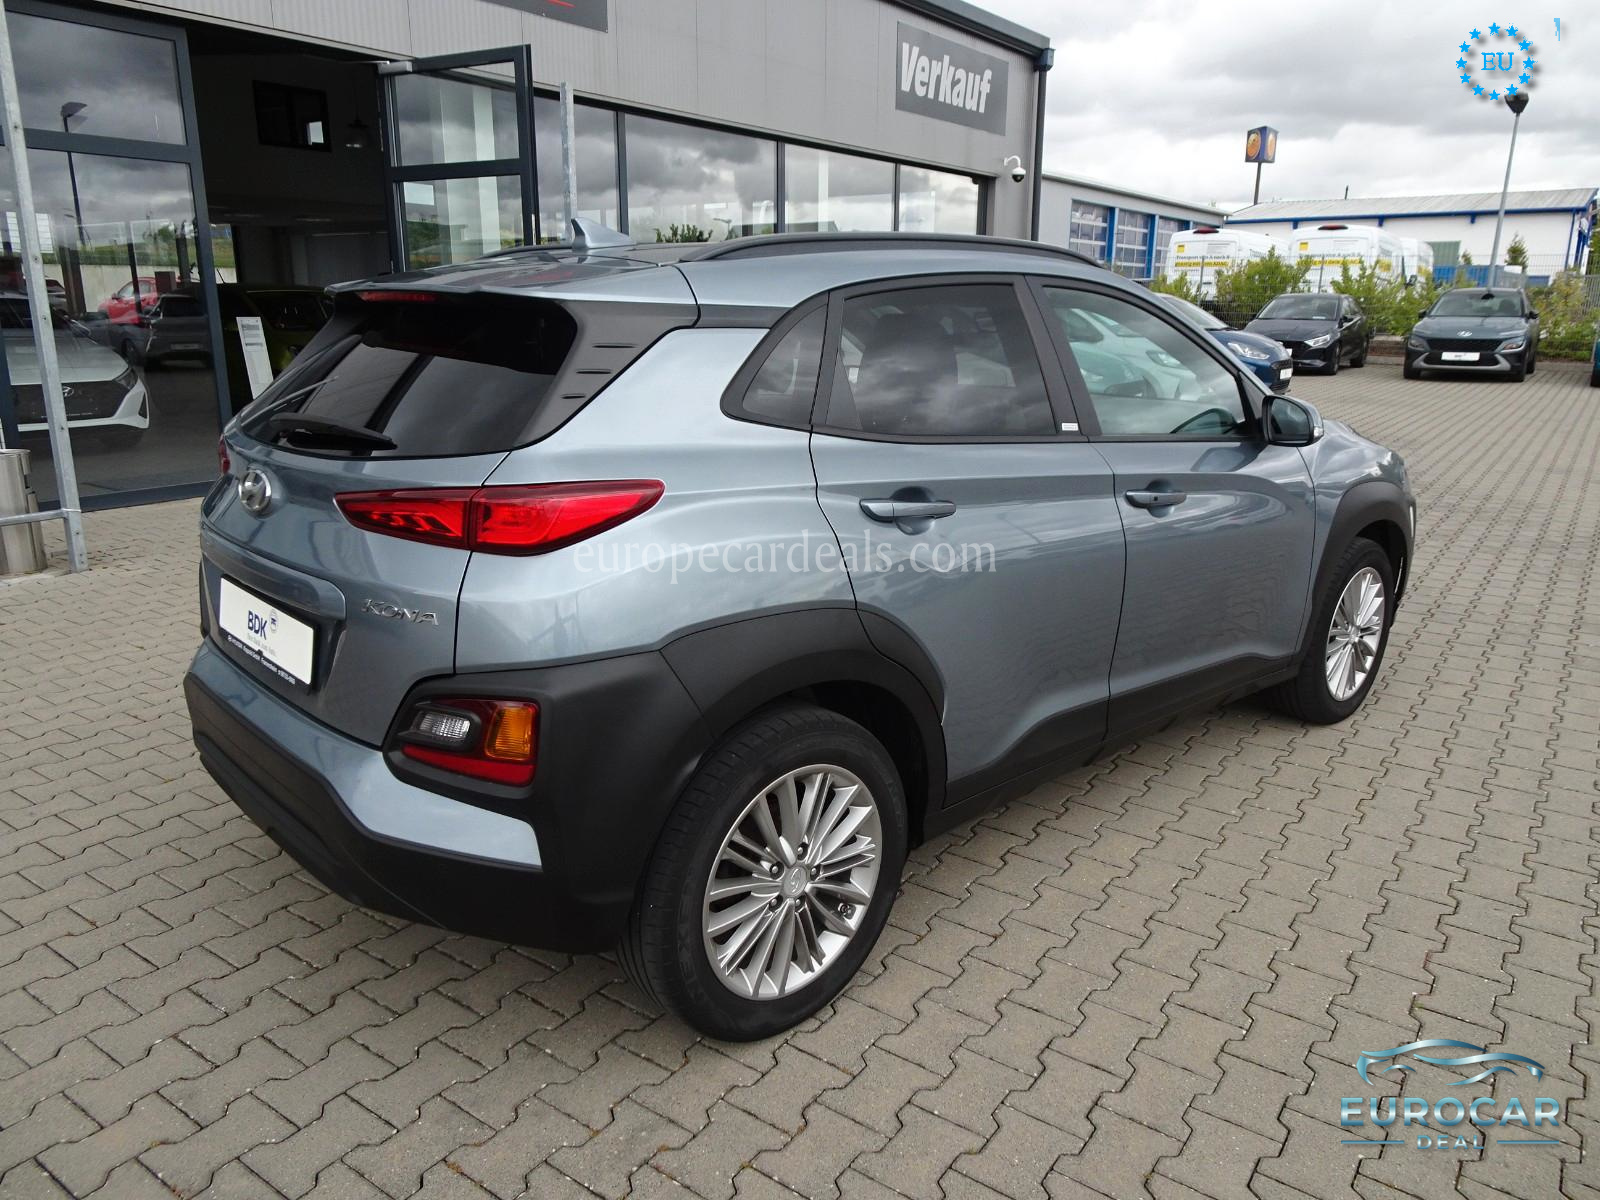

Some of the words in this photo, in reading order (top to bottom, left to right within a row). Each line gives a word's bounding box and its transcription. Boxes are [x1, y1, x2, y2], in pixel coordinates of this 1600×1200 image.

[901, 42, 992, 113] Verkauf
[247, 609, 267, 640] BDK
[361, 599, 439, 625] KONA
